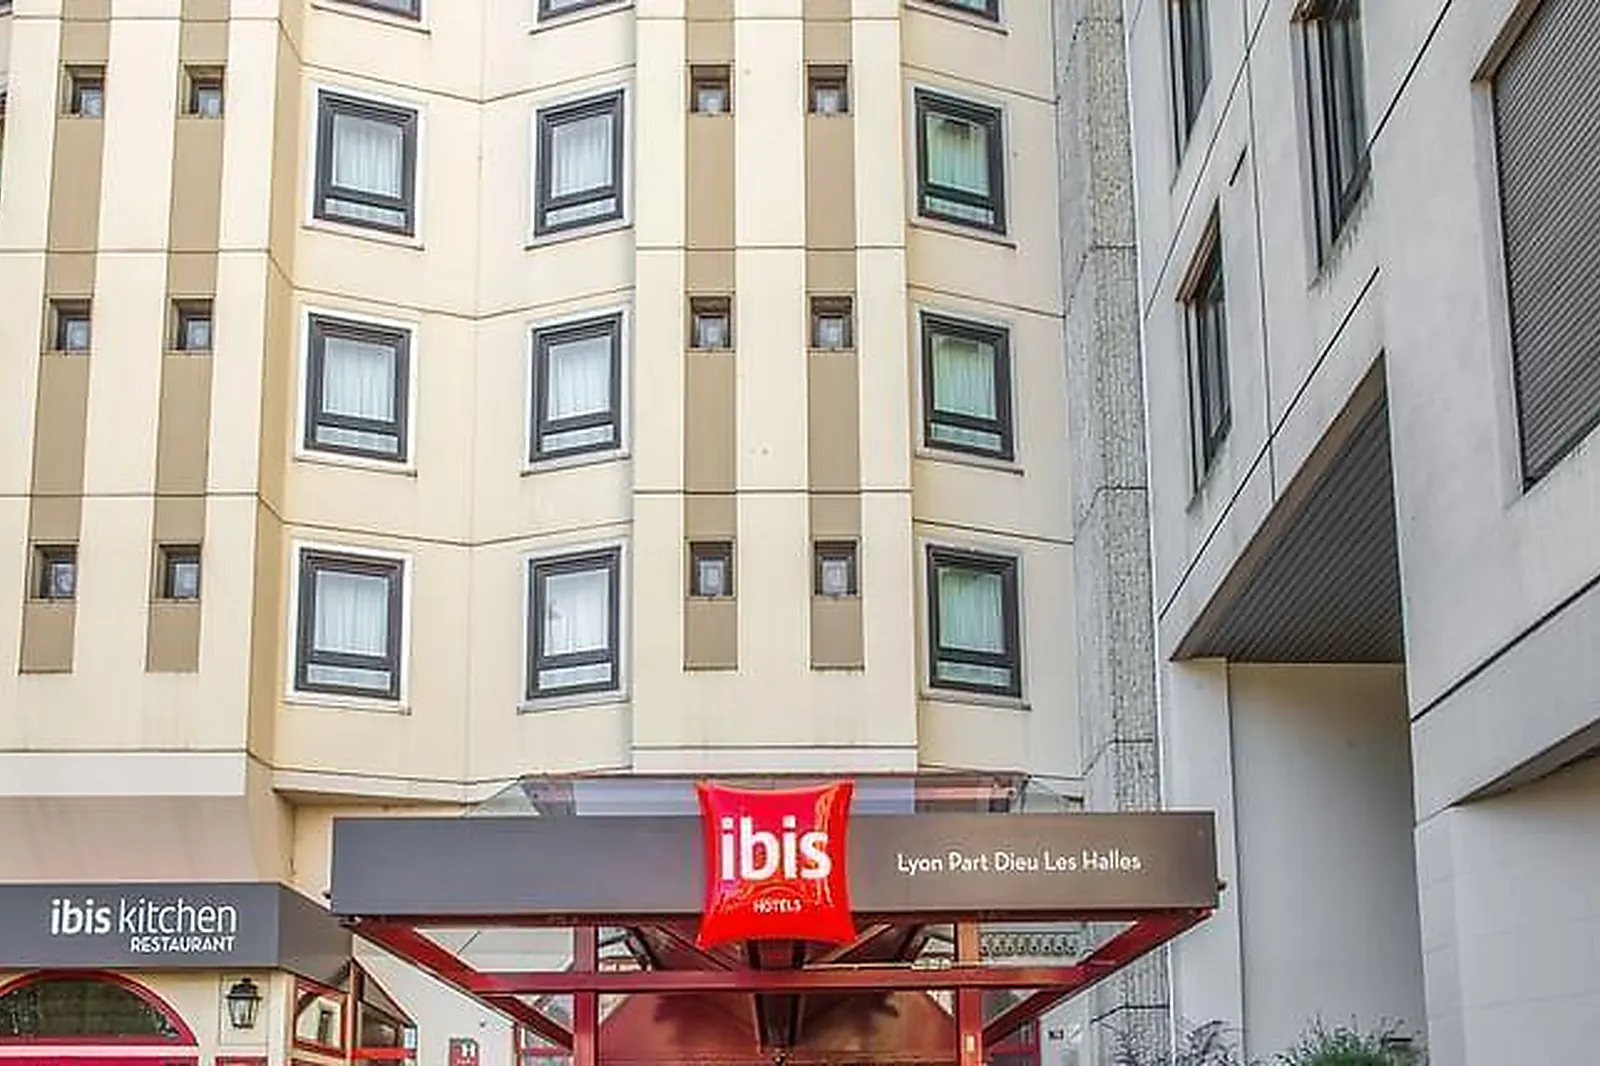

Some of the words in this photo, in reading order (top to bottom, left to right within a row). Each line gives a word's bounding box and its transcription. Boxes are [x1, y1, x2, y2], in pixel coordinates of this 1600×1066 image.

[720, 814, 833, 881] ibis
[897, 852, 943, 876] Lyon
[949, 851, 989, 872] Part
[995, 851, 1039, 872] Dieu
[1044, 850, 1077, 872] Les
[1082, 848, 1142, 871] Halles
[51, 898, 111, 935] ibis
[118, 897, 237, 934] kitchen
[752, 898, 802, 913] HOTELS
[130, 935, 236, 953] RESTAURANT
